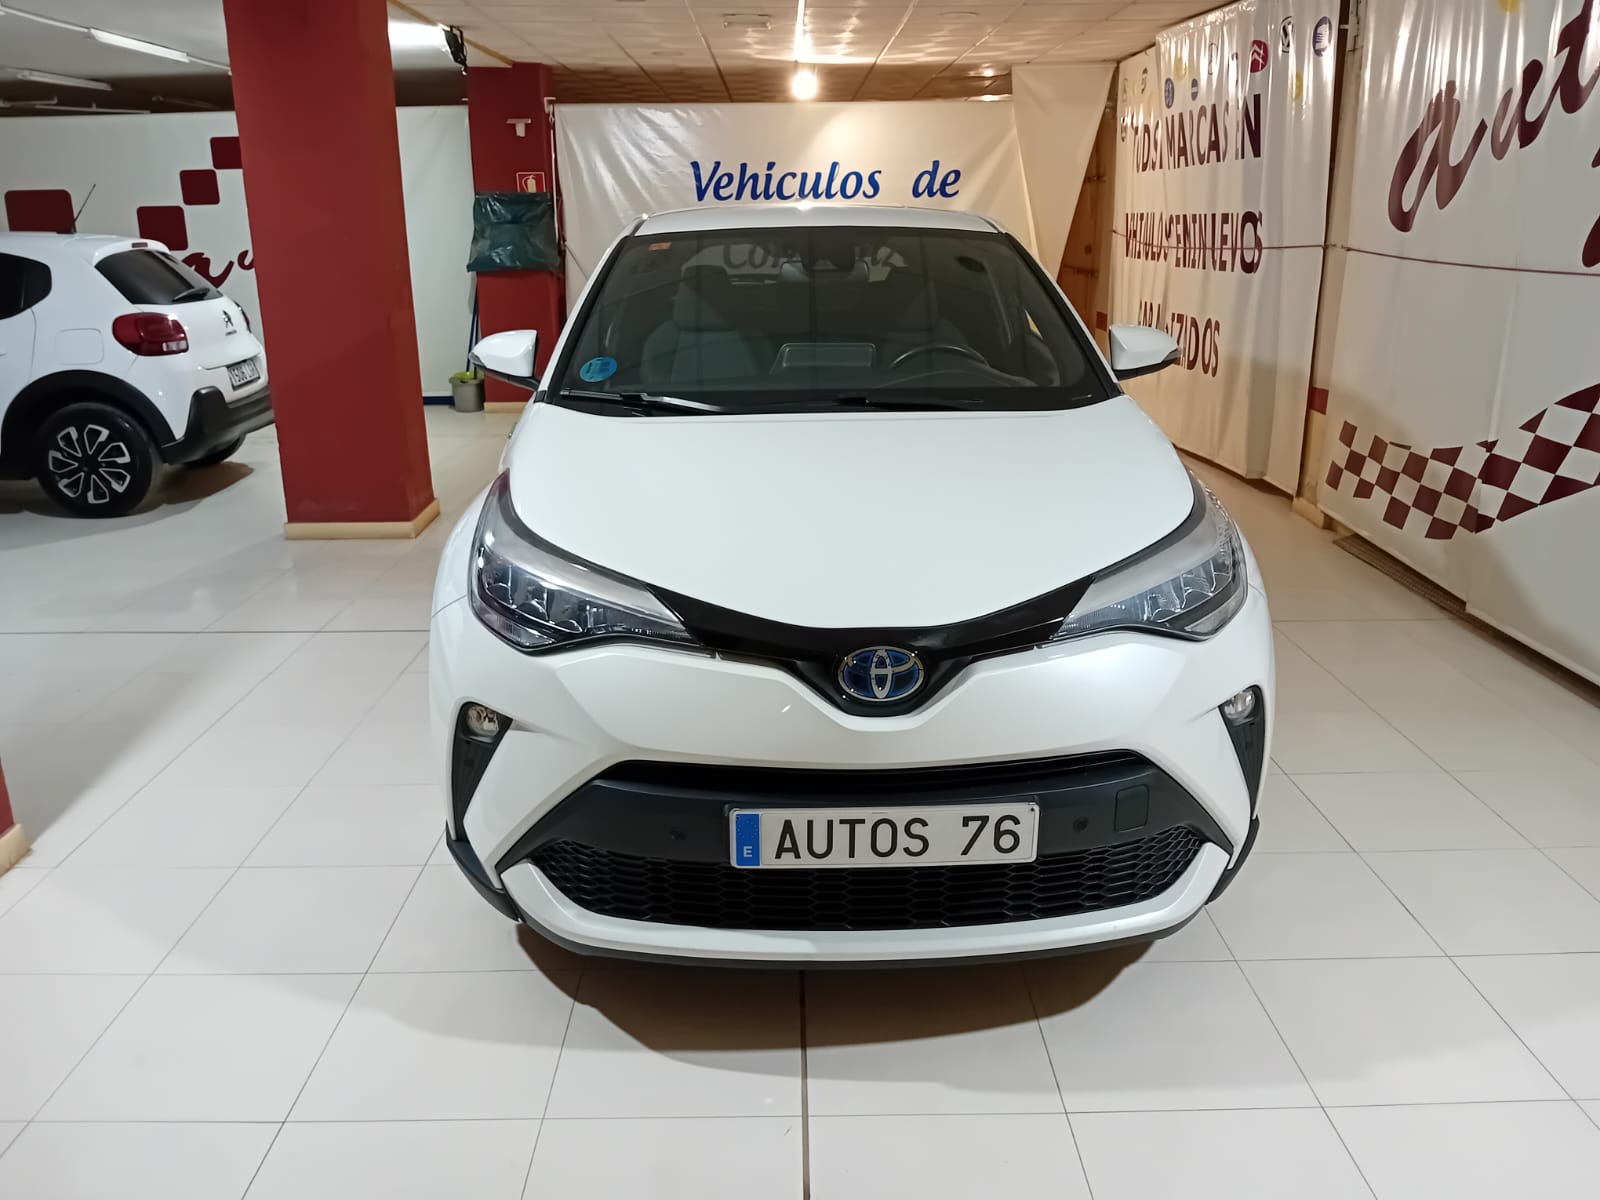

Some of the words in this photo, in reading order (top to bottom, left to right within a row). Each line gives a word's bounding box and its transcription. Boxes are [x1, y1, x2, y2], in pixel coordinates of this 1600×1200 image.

[690, 160, 881, 202] Vehiculos
[912, 159, 961, 199] de
[743, 845, 753, 858] E
[774, 817, 930, 860] AUTOS
[960, 814, 1022, 856] 76
